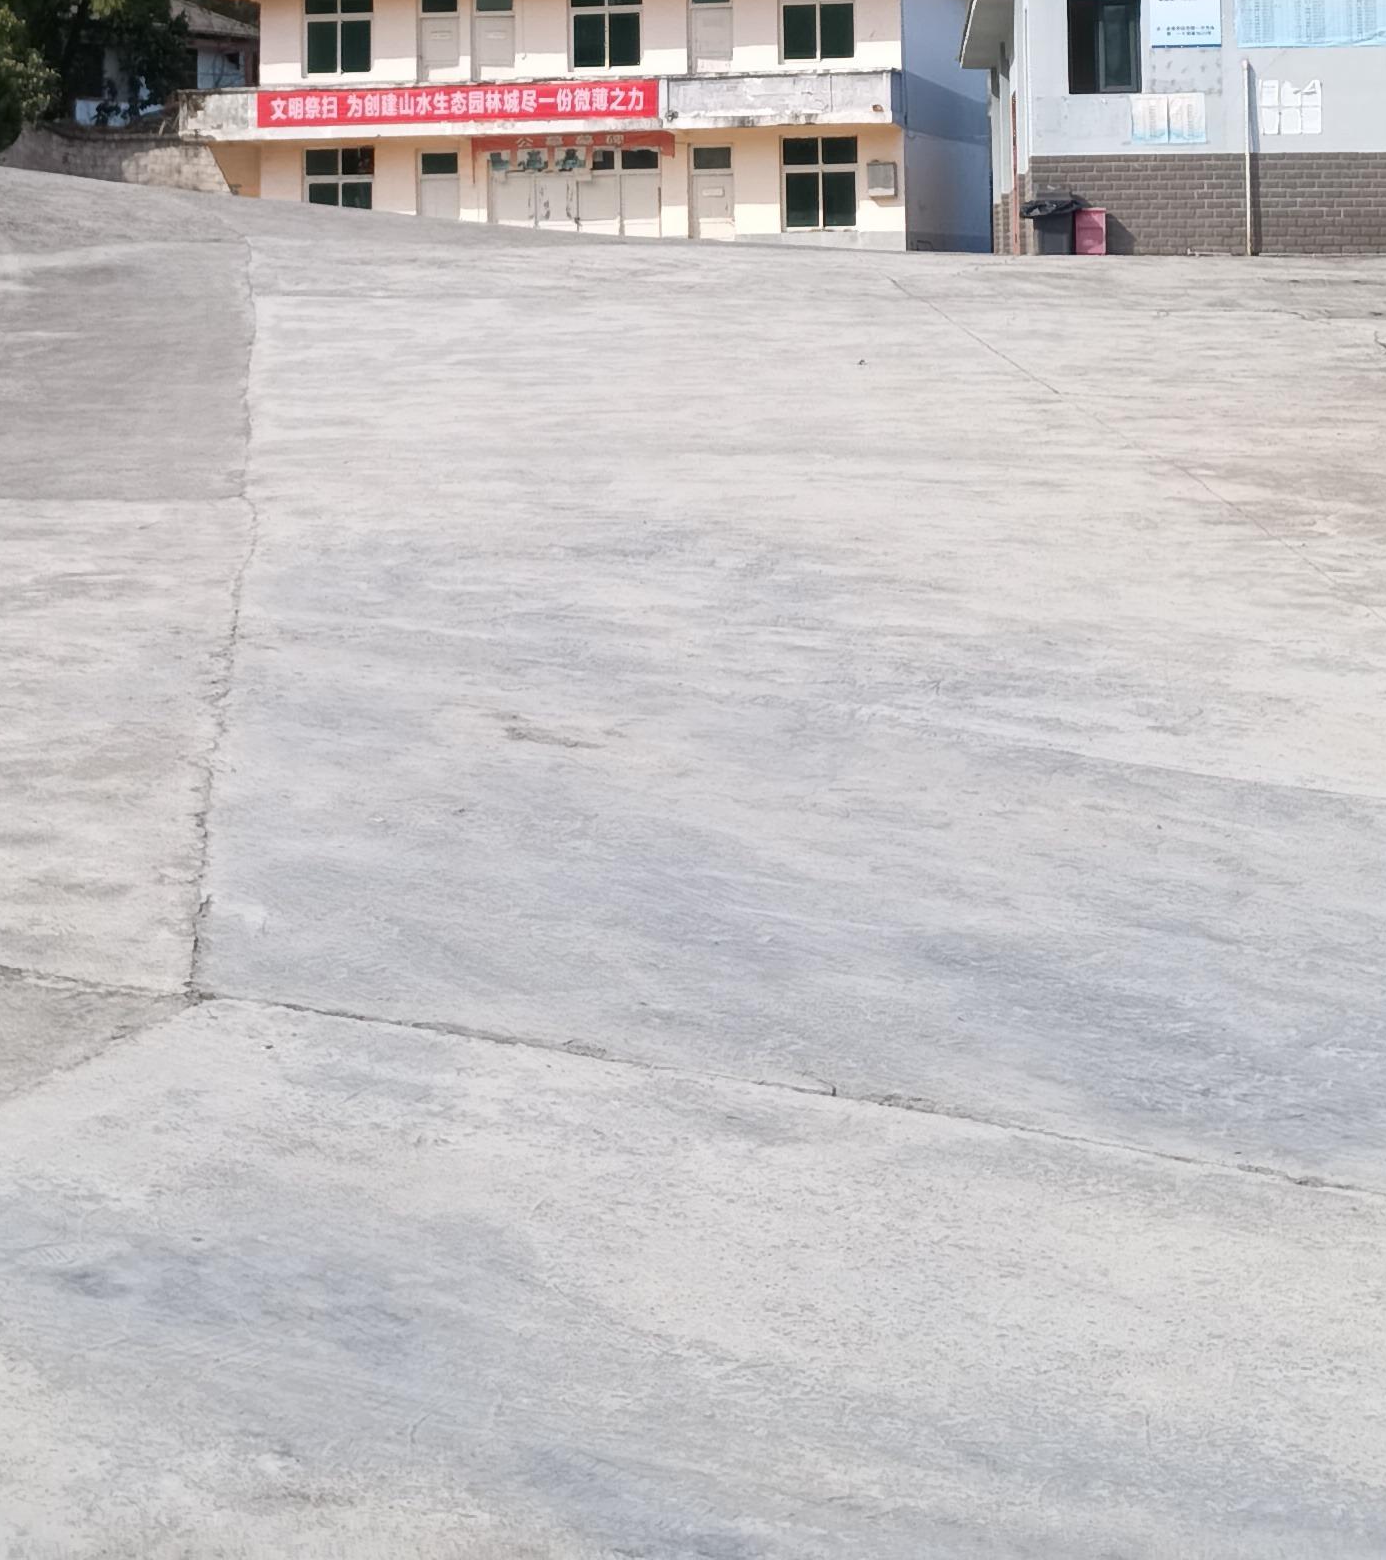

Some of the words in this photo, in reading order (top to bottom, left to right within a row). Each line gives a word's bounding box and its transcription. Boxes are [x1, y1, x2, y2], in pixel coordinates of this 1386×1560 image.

[269, 95, 339, 121] 文明祭扫
[346, 87, 645, 118] 为创建山水生态园林城尽一份微薄之力
